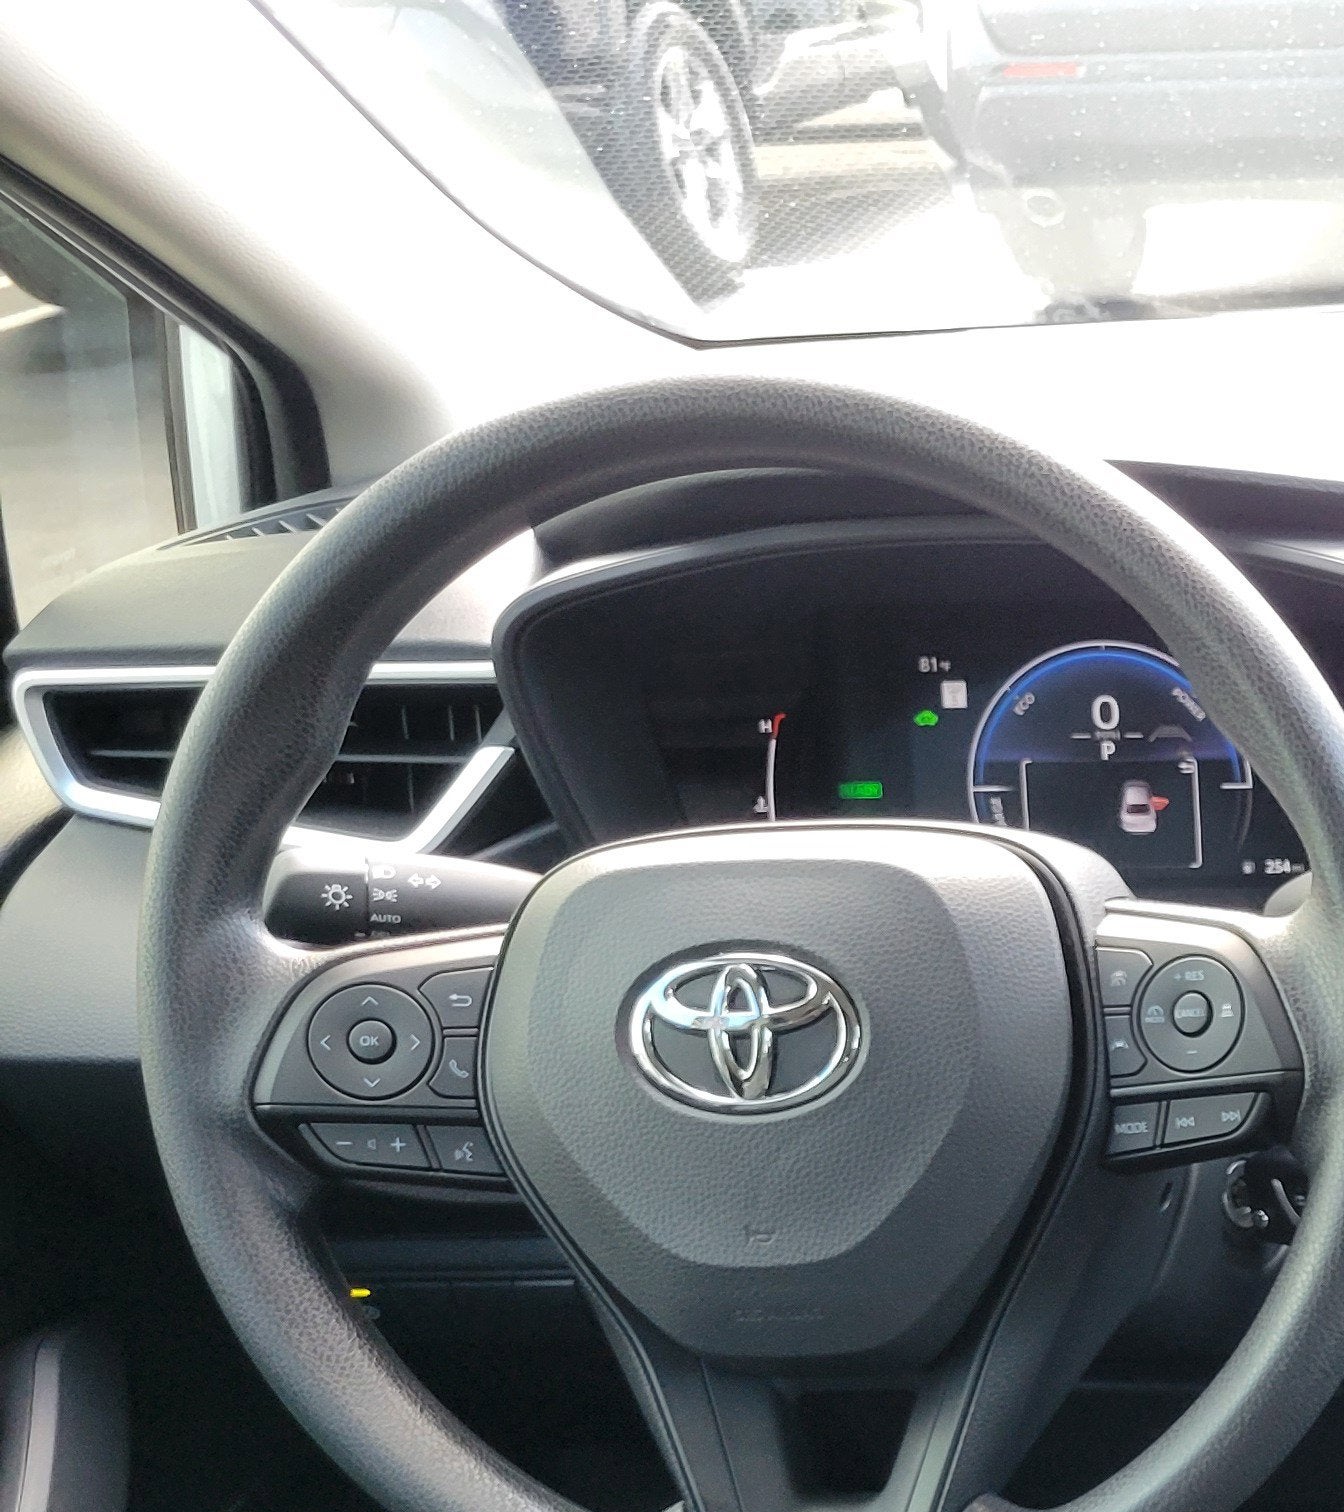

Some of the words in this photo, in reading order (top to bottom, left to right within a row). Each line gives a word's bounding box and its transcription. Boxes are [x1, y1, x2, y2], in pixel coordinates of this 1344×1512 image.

[1013, 692, 1035, 716] ECO
[1091, 694, 1120, 730] 0
[758, 718, 773, 733] H
[1101, 740, 1116, 761] P
[369, 913, 401, 924] AUTO
[1184, 970, 1205, 981] RES
[359, 1035, 380, 1046] OK
[1115, 1121, 1148, 1135] MODE
